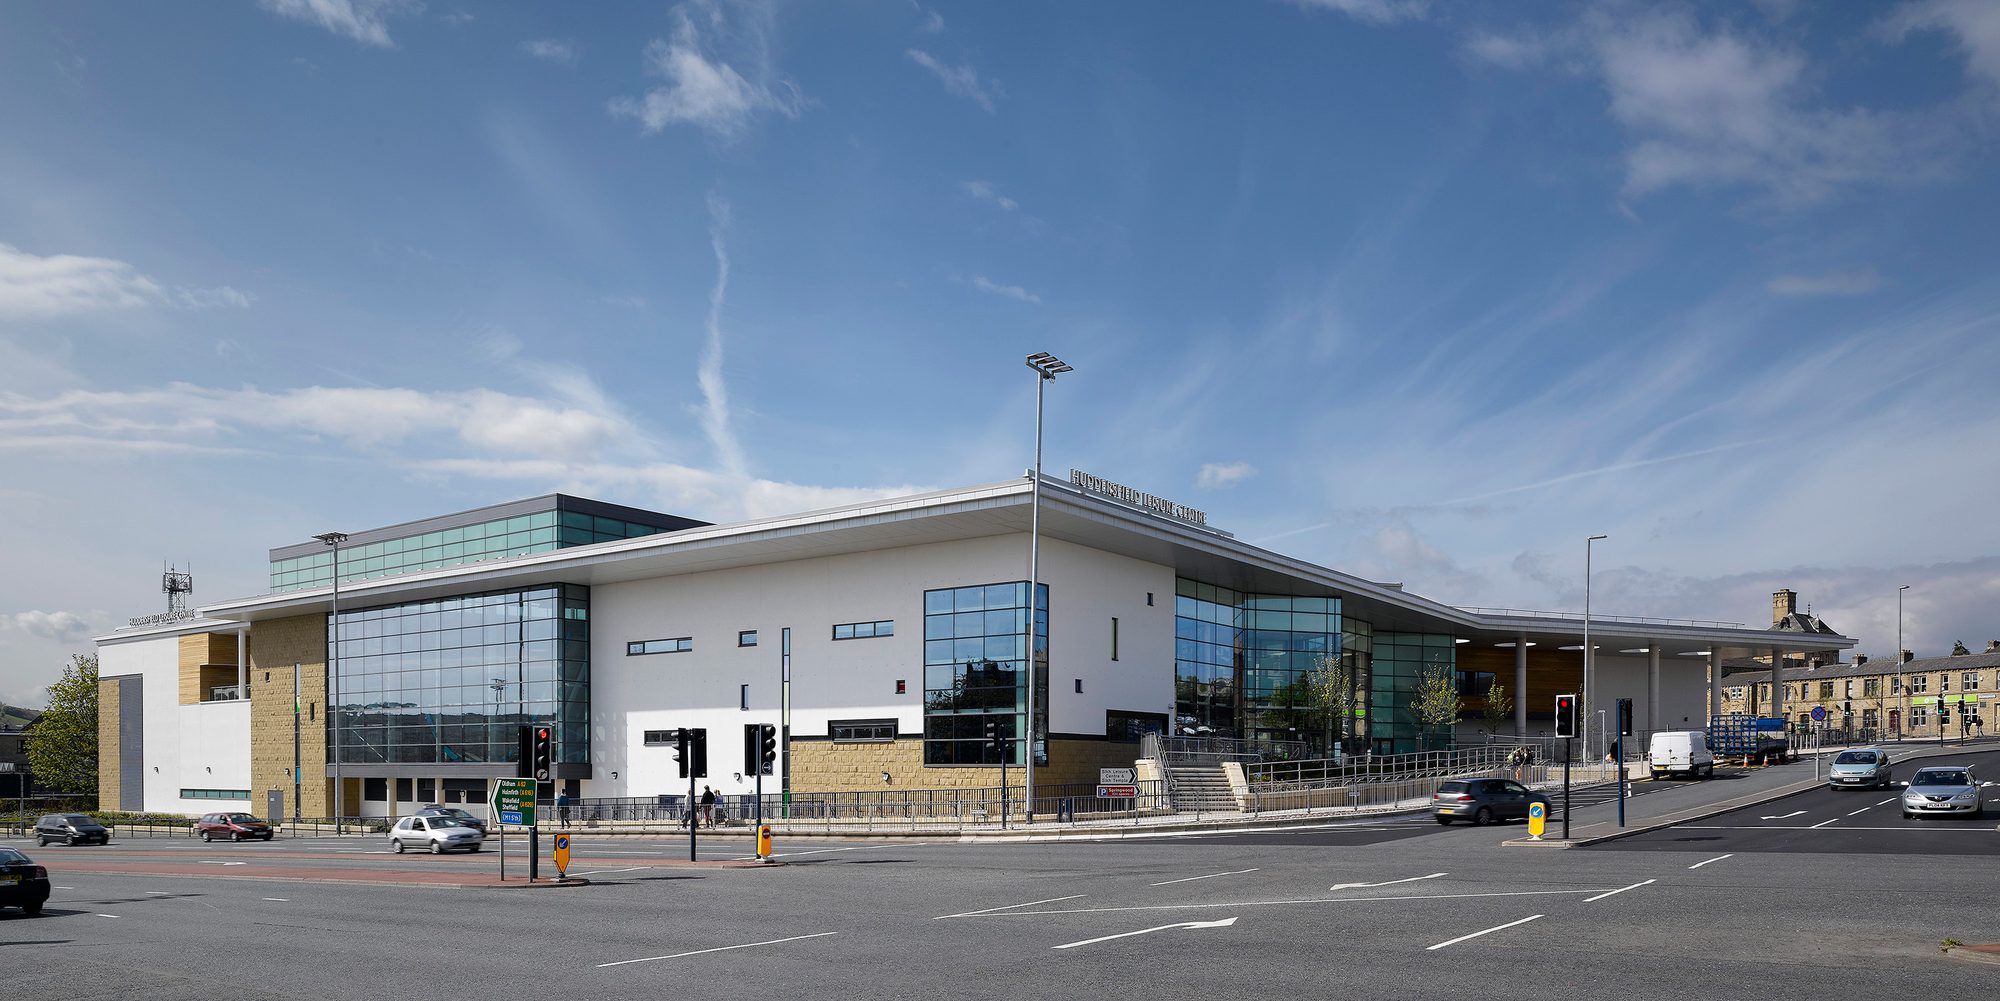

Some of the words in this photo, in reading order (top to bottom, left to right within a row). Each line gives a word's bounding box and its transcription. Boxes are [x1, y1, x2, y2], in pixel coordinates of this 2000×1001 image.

[1069, 468, 1142, 506] HUDDERSFIELD
[1142, 492, 1177, 517] LEISURE
[1175, 504, 1208, 525] CENTRE
